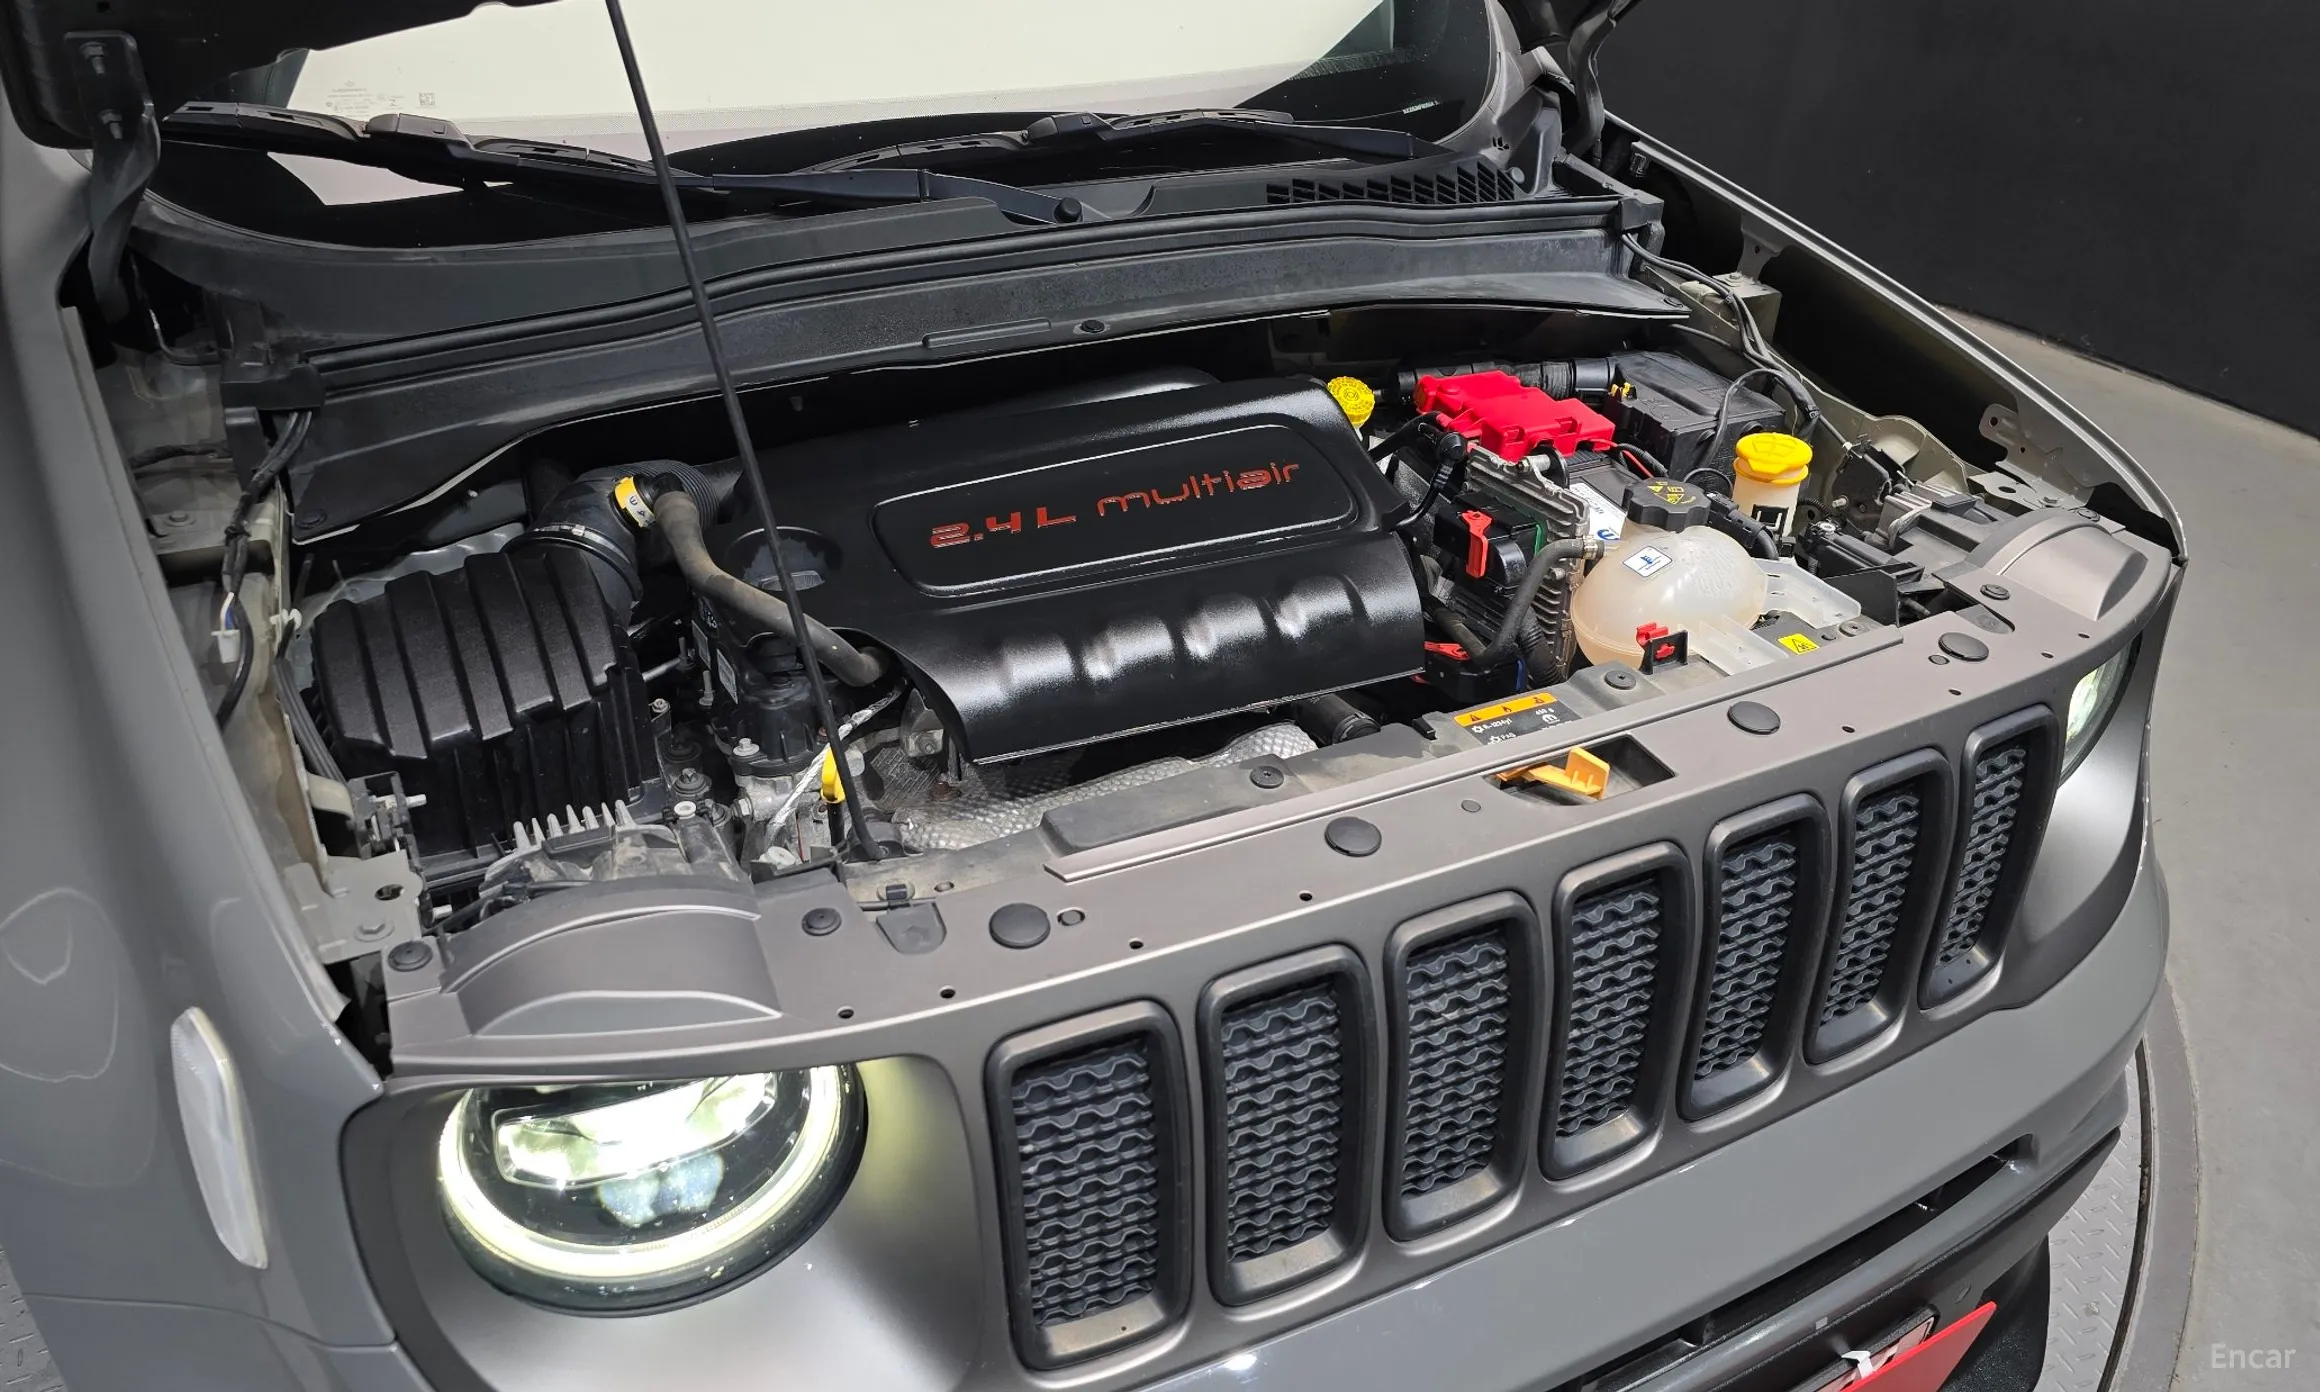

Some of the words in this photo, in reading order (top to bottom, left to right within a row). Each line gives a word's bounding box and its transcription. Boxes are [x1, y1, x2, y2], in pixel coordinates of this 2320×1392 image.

[930, 511, 1022, 549] 2.4
[1036, 506, 1077, 529] L
[1097, 462, 1300, 517] multiair
